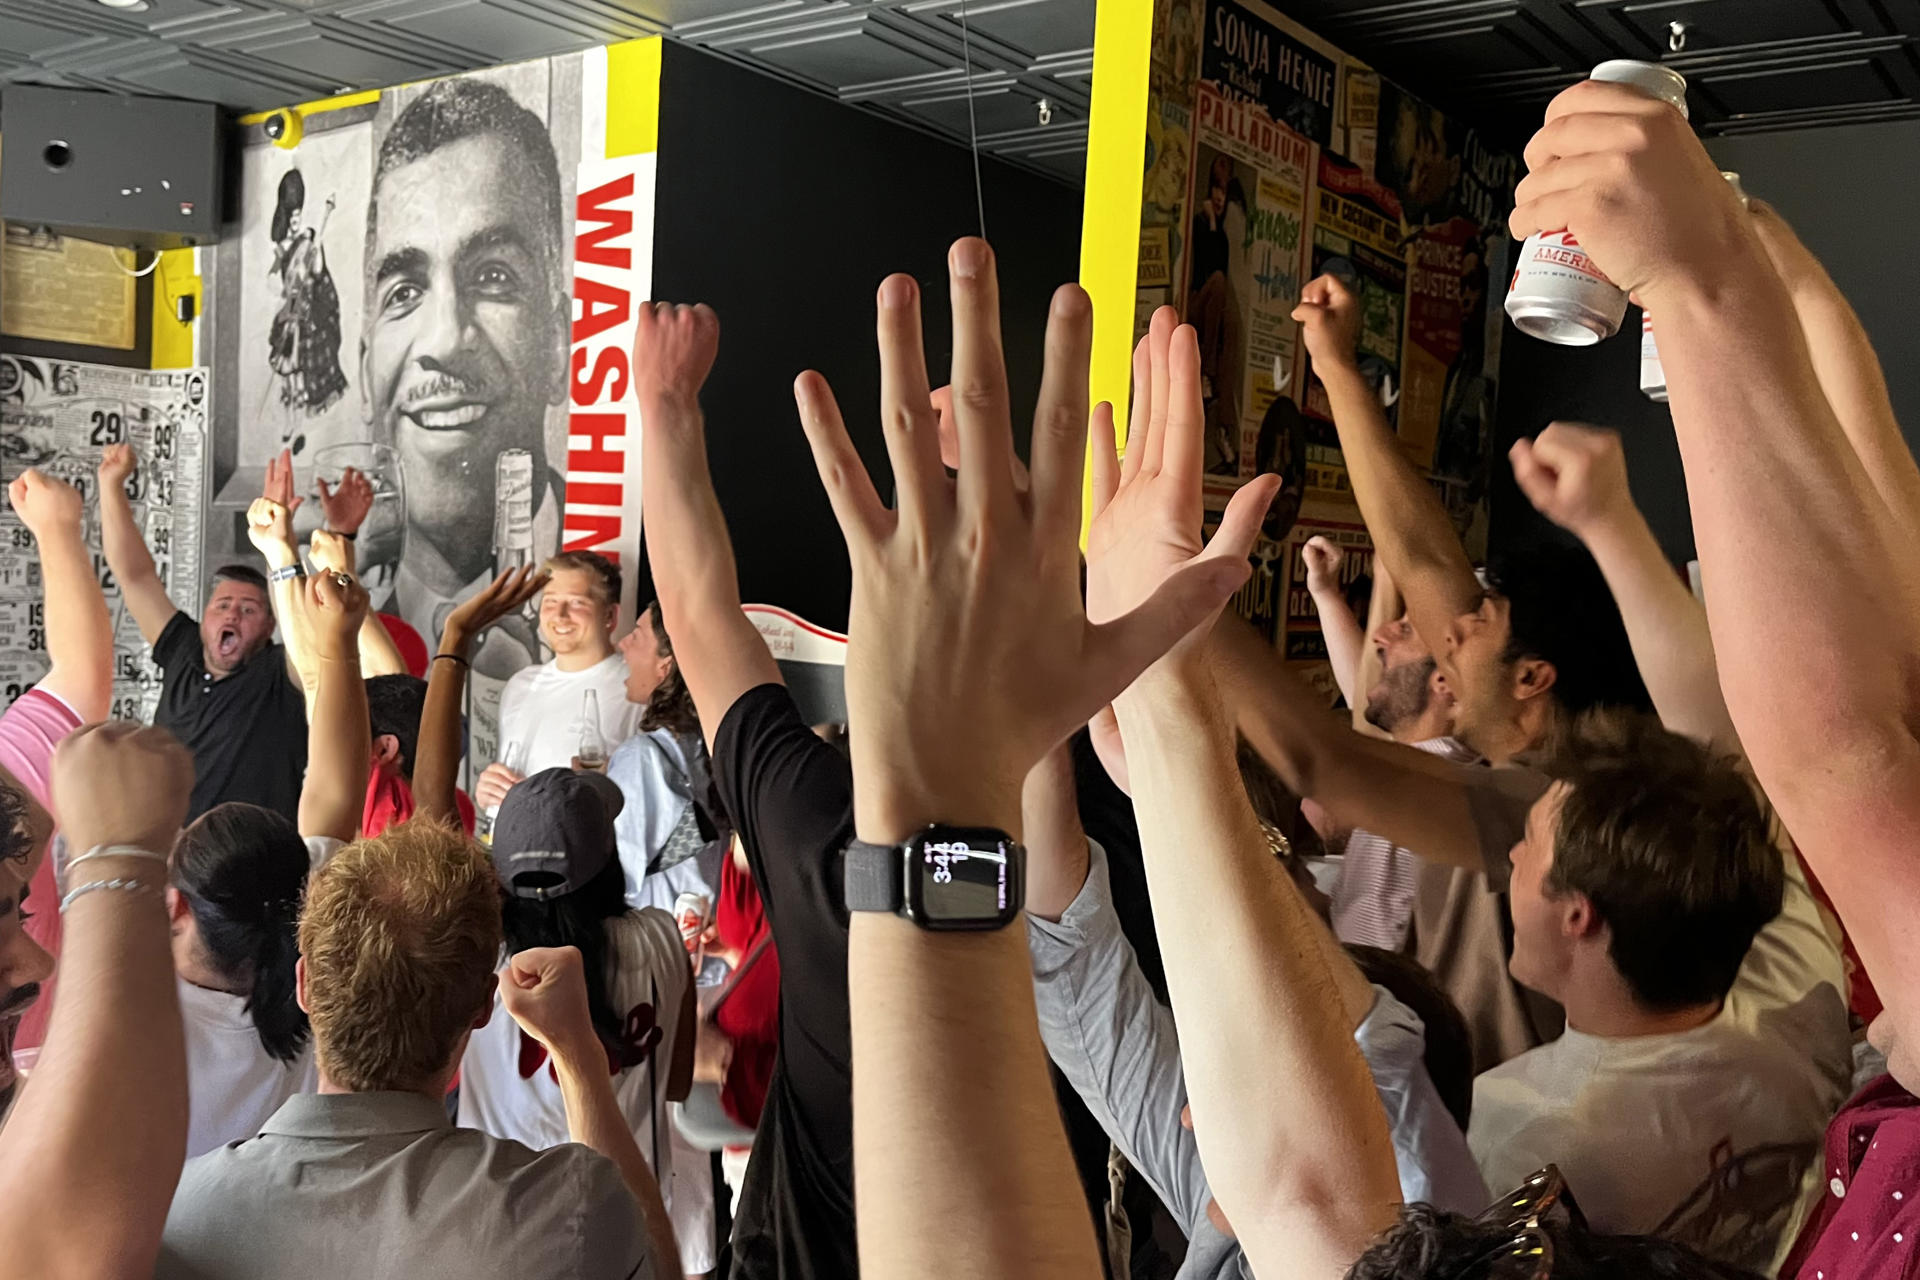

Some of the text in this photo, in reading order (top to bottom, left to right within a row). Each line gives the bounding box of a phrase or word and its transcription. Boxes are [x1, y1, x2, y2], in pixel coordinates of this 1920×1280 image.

[1212, 5, 1272, 76] SONJA
[1277, 43, 1333, 109] HENIE
[1200, 94, 1307, 169] PALLADIUM
[1533, 247, 1606, 278] AMERIC
[1411, 268, 1463, 300] BUSTER
[90, 410, 121, 447] 29
[154, 425, 172, 460] 99
[12, 528, 32, 548] 39
[933, 842, 952, 884] 3:44
